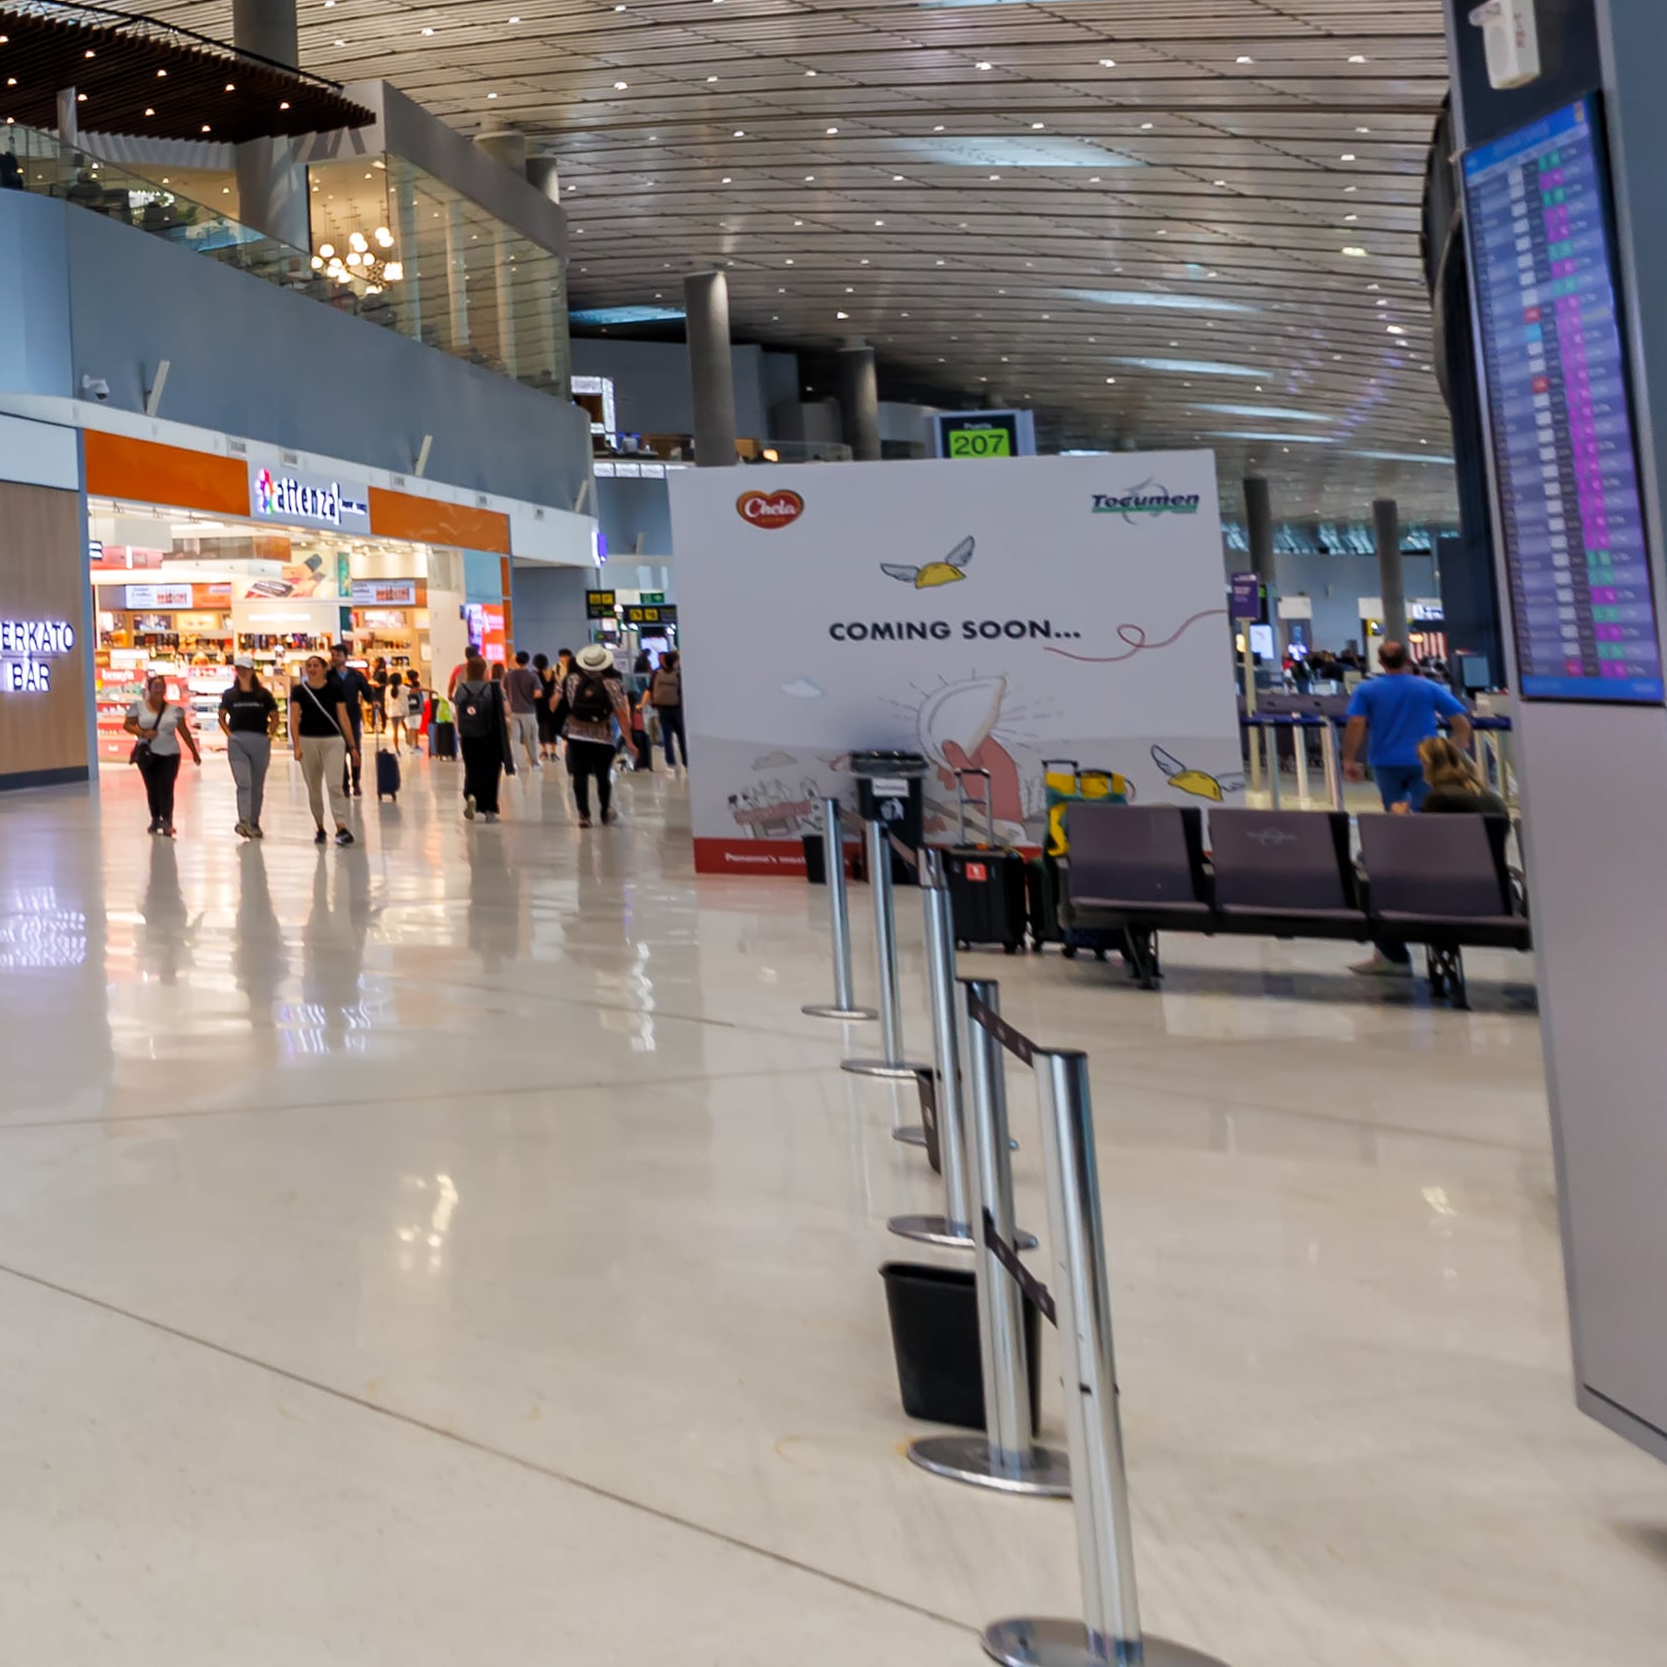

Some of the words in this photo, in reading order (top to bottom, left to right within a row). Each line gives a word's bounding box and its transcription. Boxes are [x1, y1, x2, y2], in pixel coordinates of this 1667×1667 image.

[953, 434, 1005, 455] 207
[1091, 493, 1200, 508] Tocumen
[828, 620, 952, 641] COMING
[961, 619, 1082, 640] SOON...
[11, 662, 51, 692] BAR
